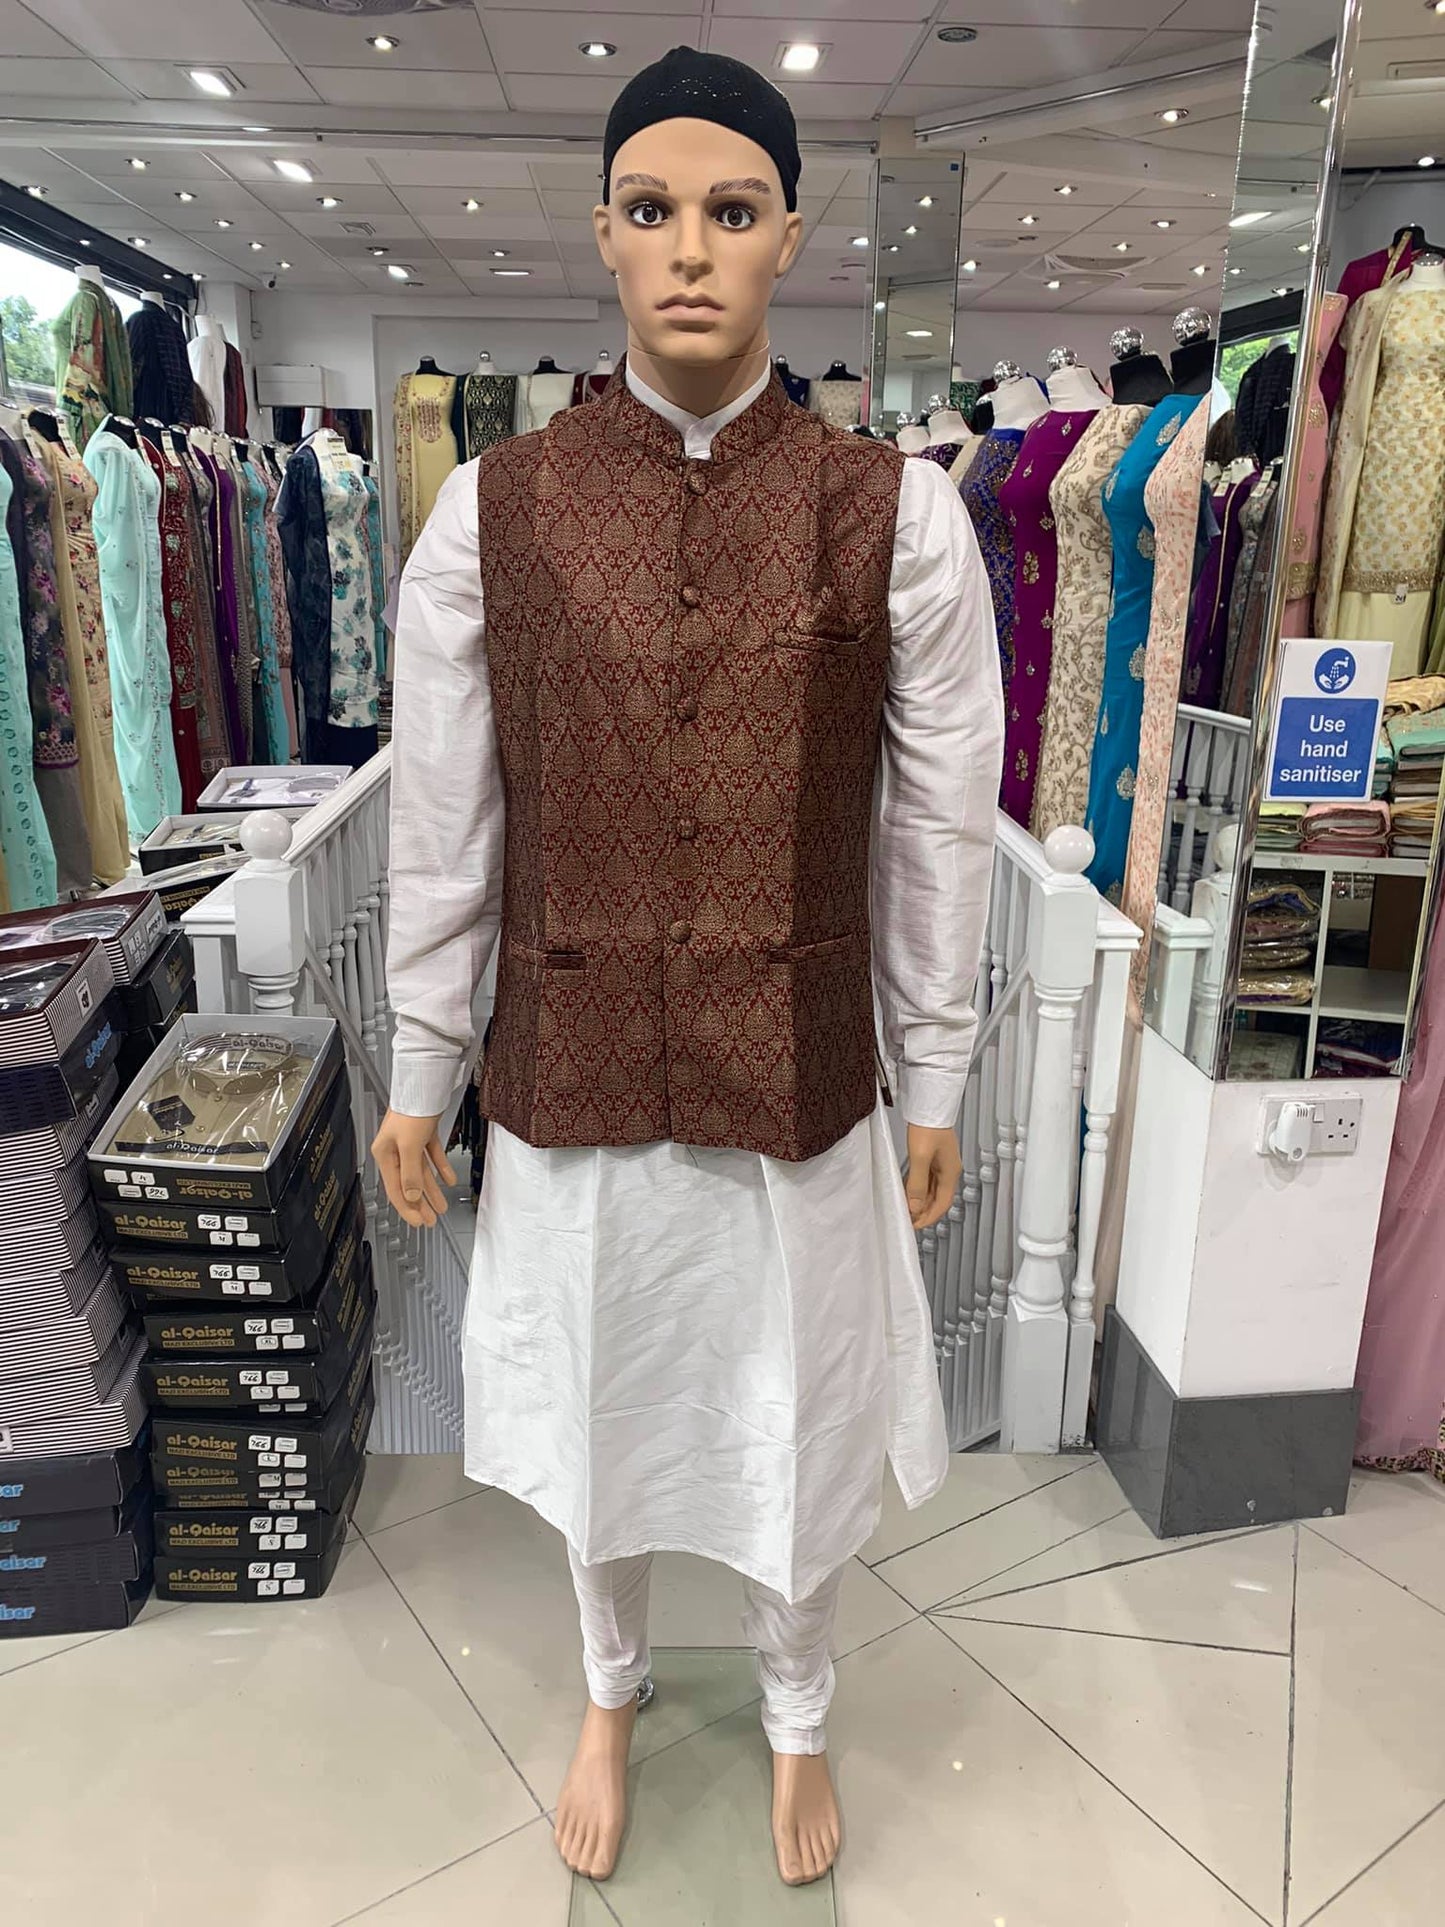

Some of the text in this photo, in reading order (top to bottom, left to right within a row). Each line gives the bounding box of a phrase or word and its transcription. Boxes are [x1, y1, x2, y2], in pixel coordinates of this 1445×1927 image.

[1309, 714, 1346, 733] Use
[1300, 740, 1348, 758] hand
[1279, 765, 1362, 783] sanitiser
[115, 1215, 187, 1231] al-Qaisar
[126, 1266, 199, 1281] al-Qaisar
[161, 1326, 234, 1339] al-Qaisar
[156, 1375, 229, 1387] al-Qaisar
[166, 1434, 238, 1450] al-Qaisar
[169, 1523, 239, 1537] al-Qaisar
[168, 1568, 238, 1581] al-Qaisar
